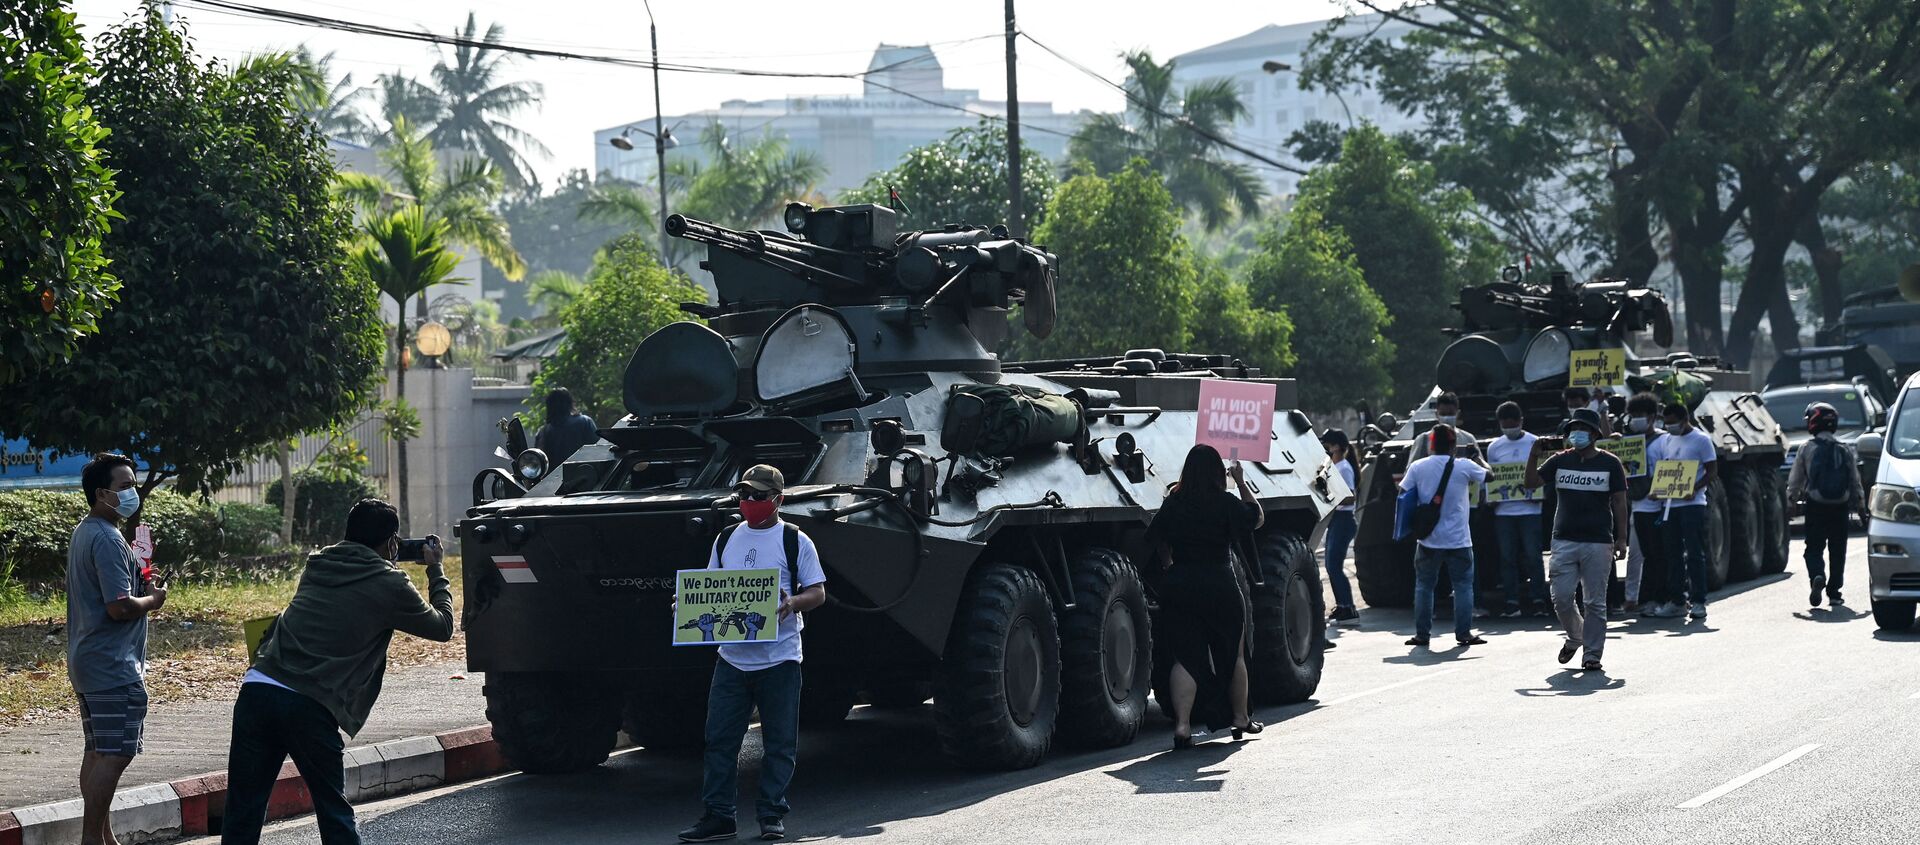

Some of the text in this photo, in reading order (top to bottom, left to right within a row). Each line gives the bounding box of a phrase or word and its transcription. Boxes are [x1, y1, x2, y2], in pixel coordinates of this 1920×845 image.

[1559, 474, 1591, 485] adidas
[683, 576, 774, 590] We Don't Accept
[684, 590, 772, 604] MILITARY COUP
